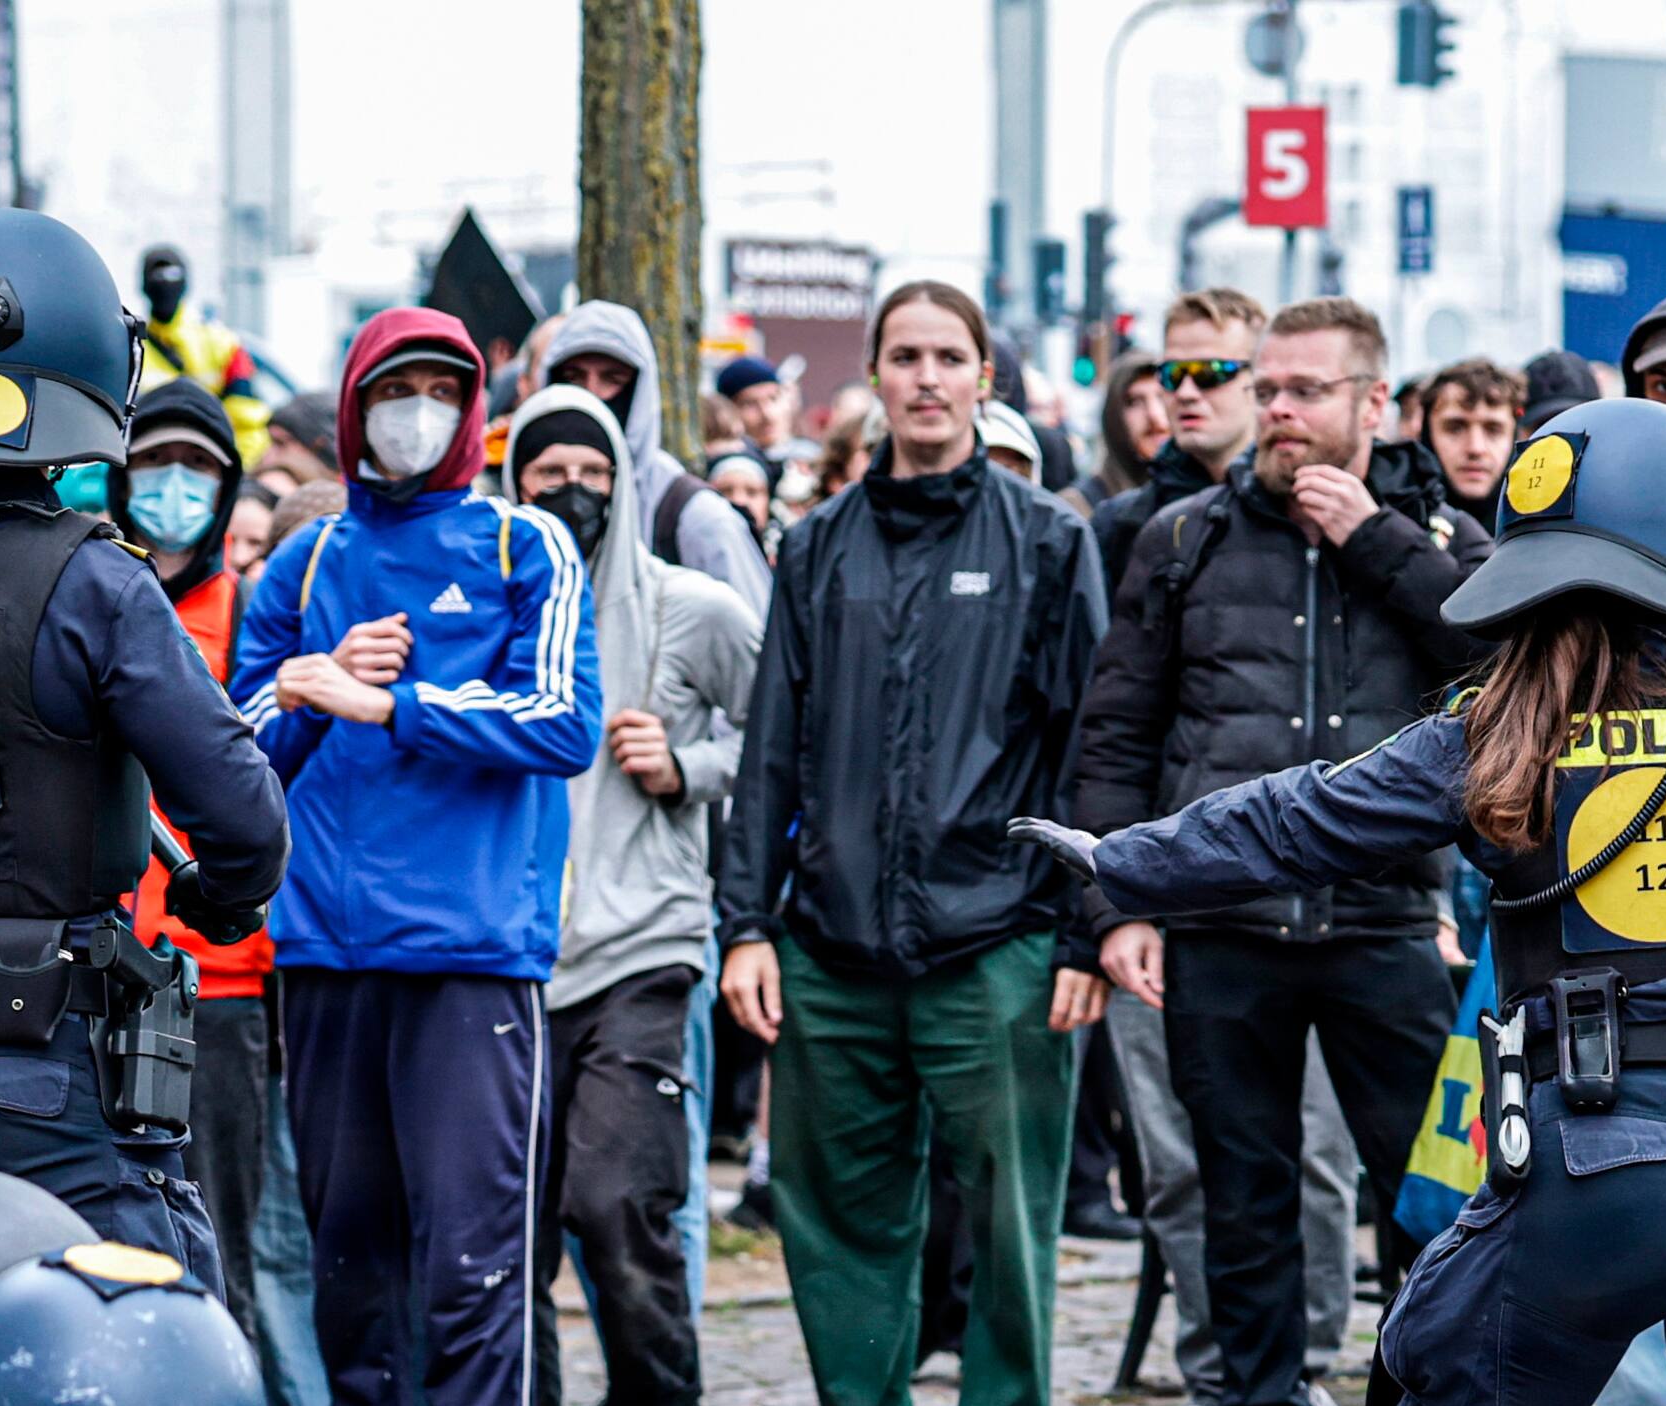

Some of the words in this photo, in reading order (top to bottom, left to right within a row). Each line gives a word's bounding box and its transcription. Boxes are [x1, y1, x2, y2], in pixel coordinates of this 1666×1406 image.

[1259, 129, 1310, 200] 5
[1532, 457, 1545, 470] 11
[1527, 476, 1542, 489] 12
